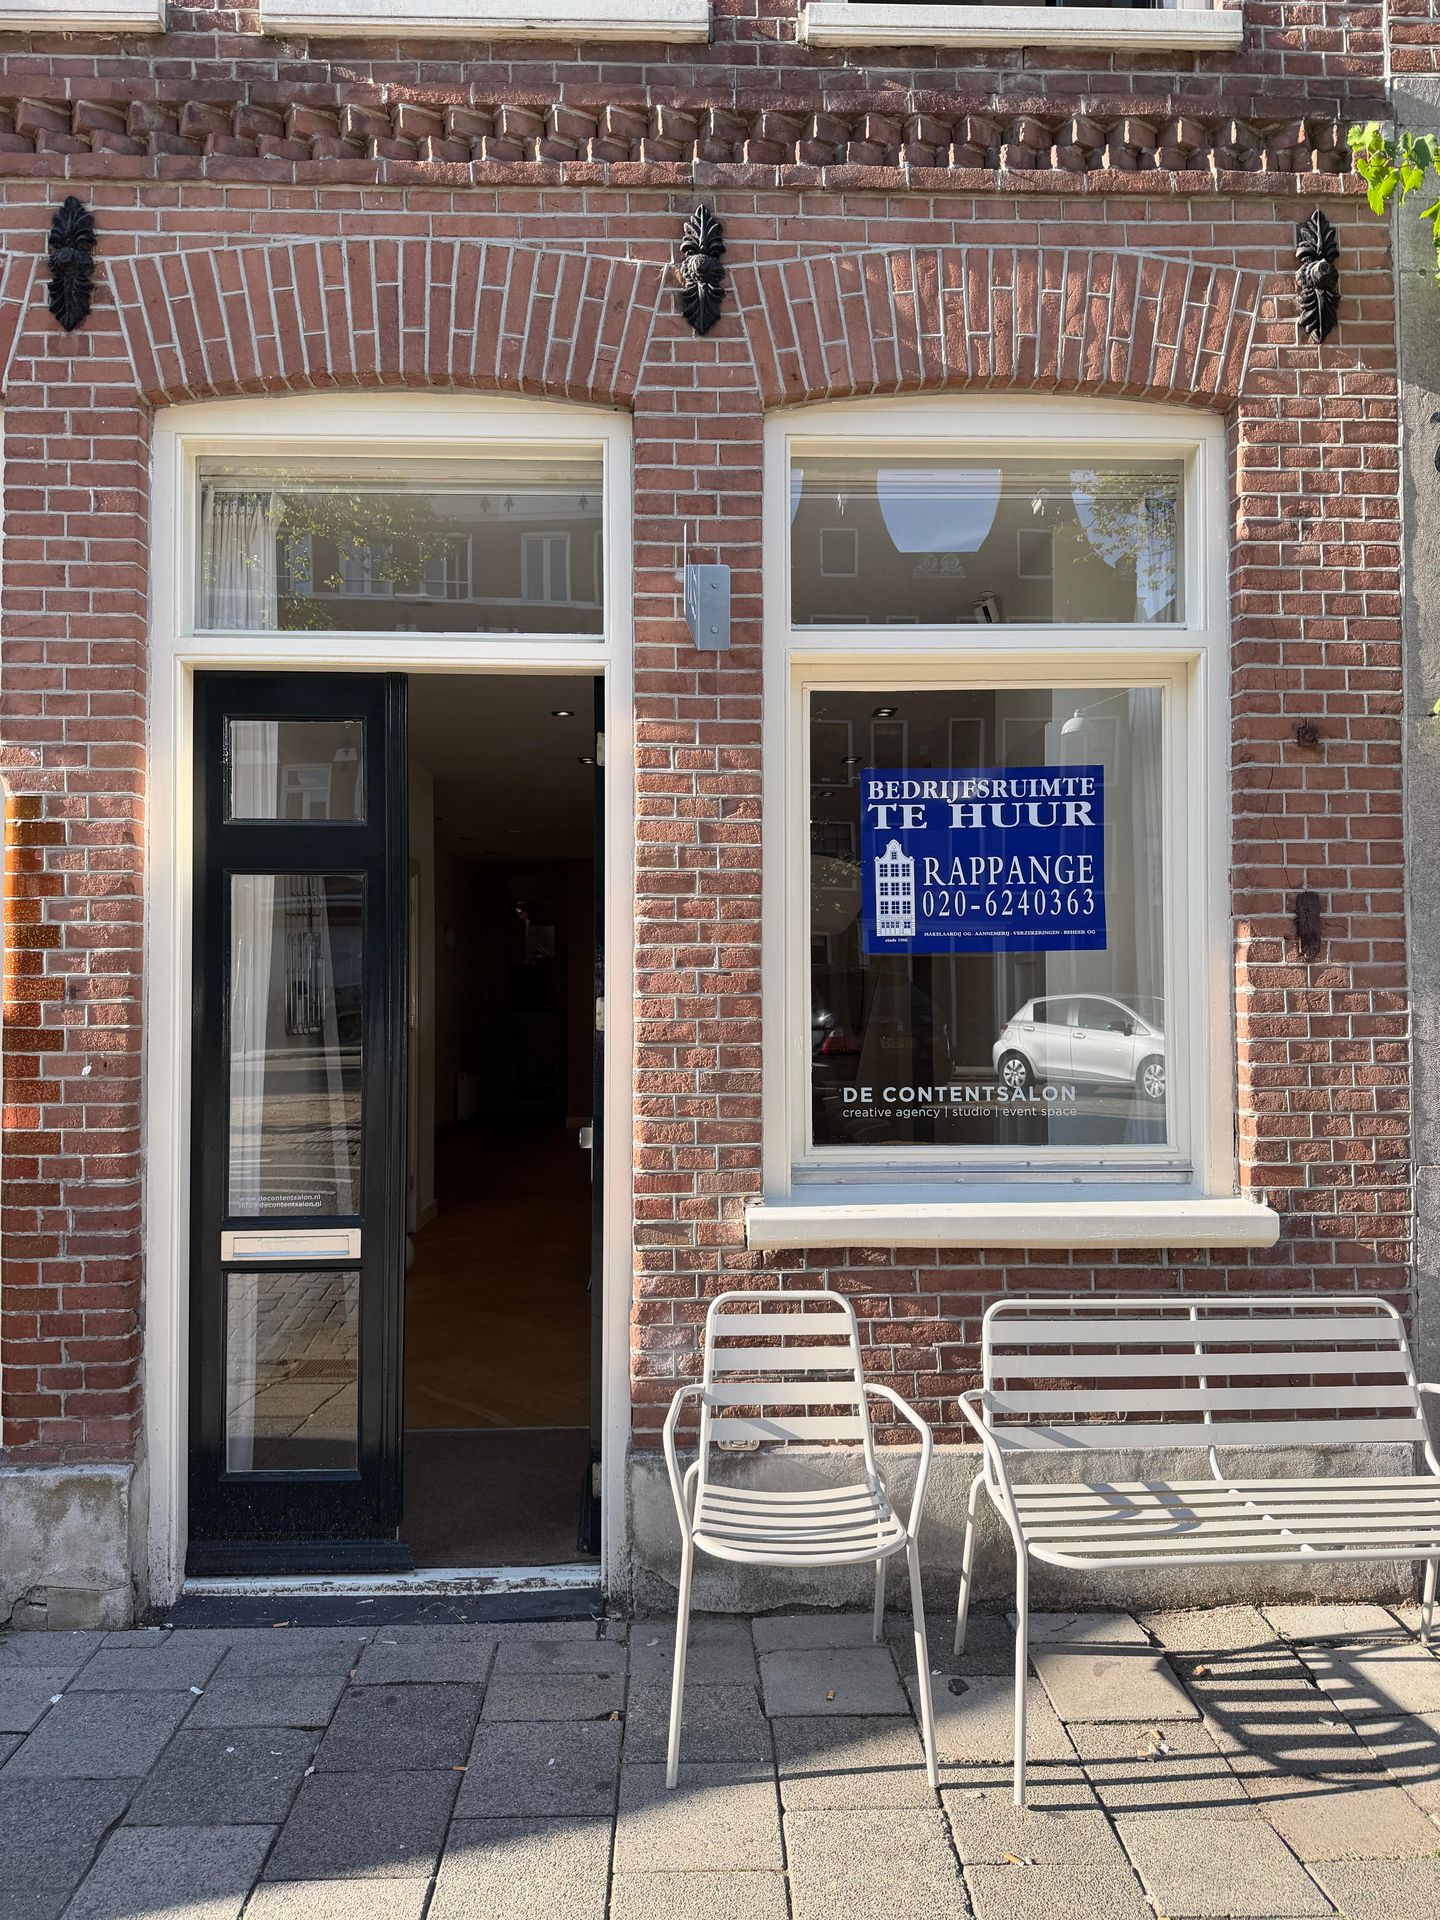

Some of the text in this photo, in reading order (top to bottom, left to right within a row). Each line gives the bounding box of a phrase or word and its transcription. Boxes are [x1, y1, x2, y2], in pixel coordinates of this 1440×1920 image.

[867, 777, 1096, 803] BEDRIJFSRUIMTE
[867, 801, 1096, 829] TE HUUR
[922, 855, 1095, 886] RAPPANGE
[922, 888, 1095, 917] 020-6240363
[843, 1086, 1076, 1103] DE CONTENTSALON
[842, 1106, 1077, 1119] creative agency studio event space
